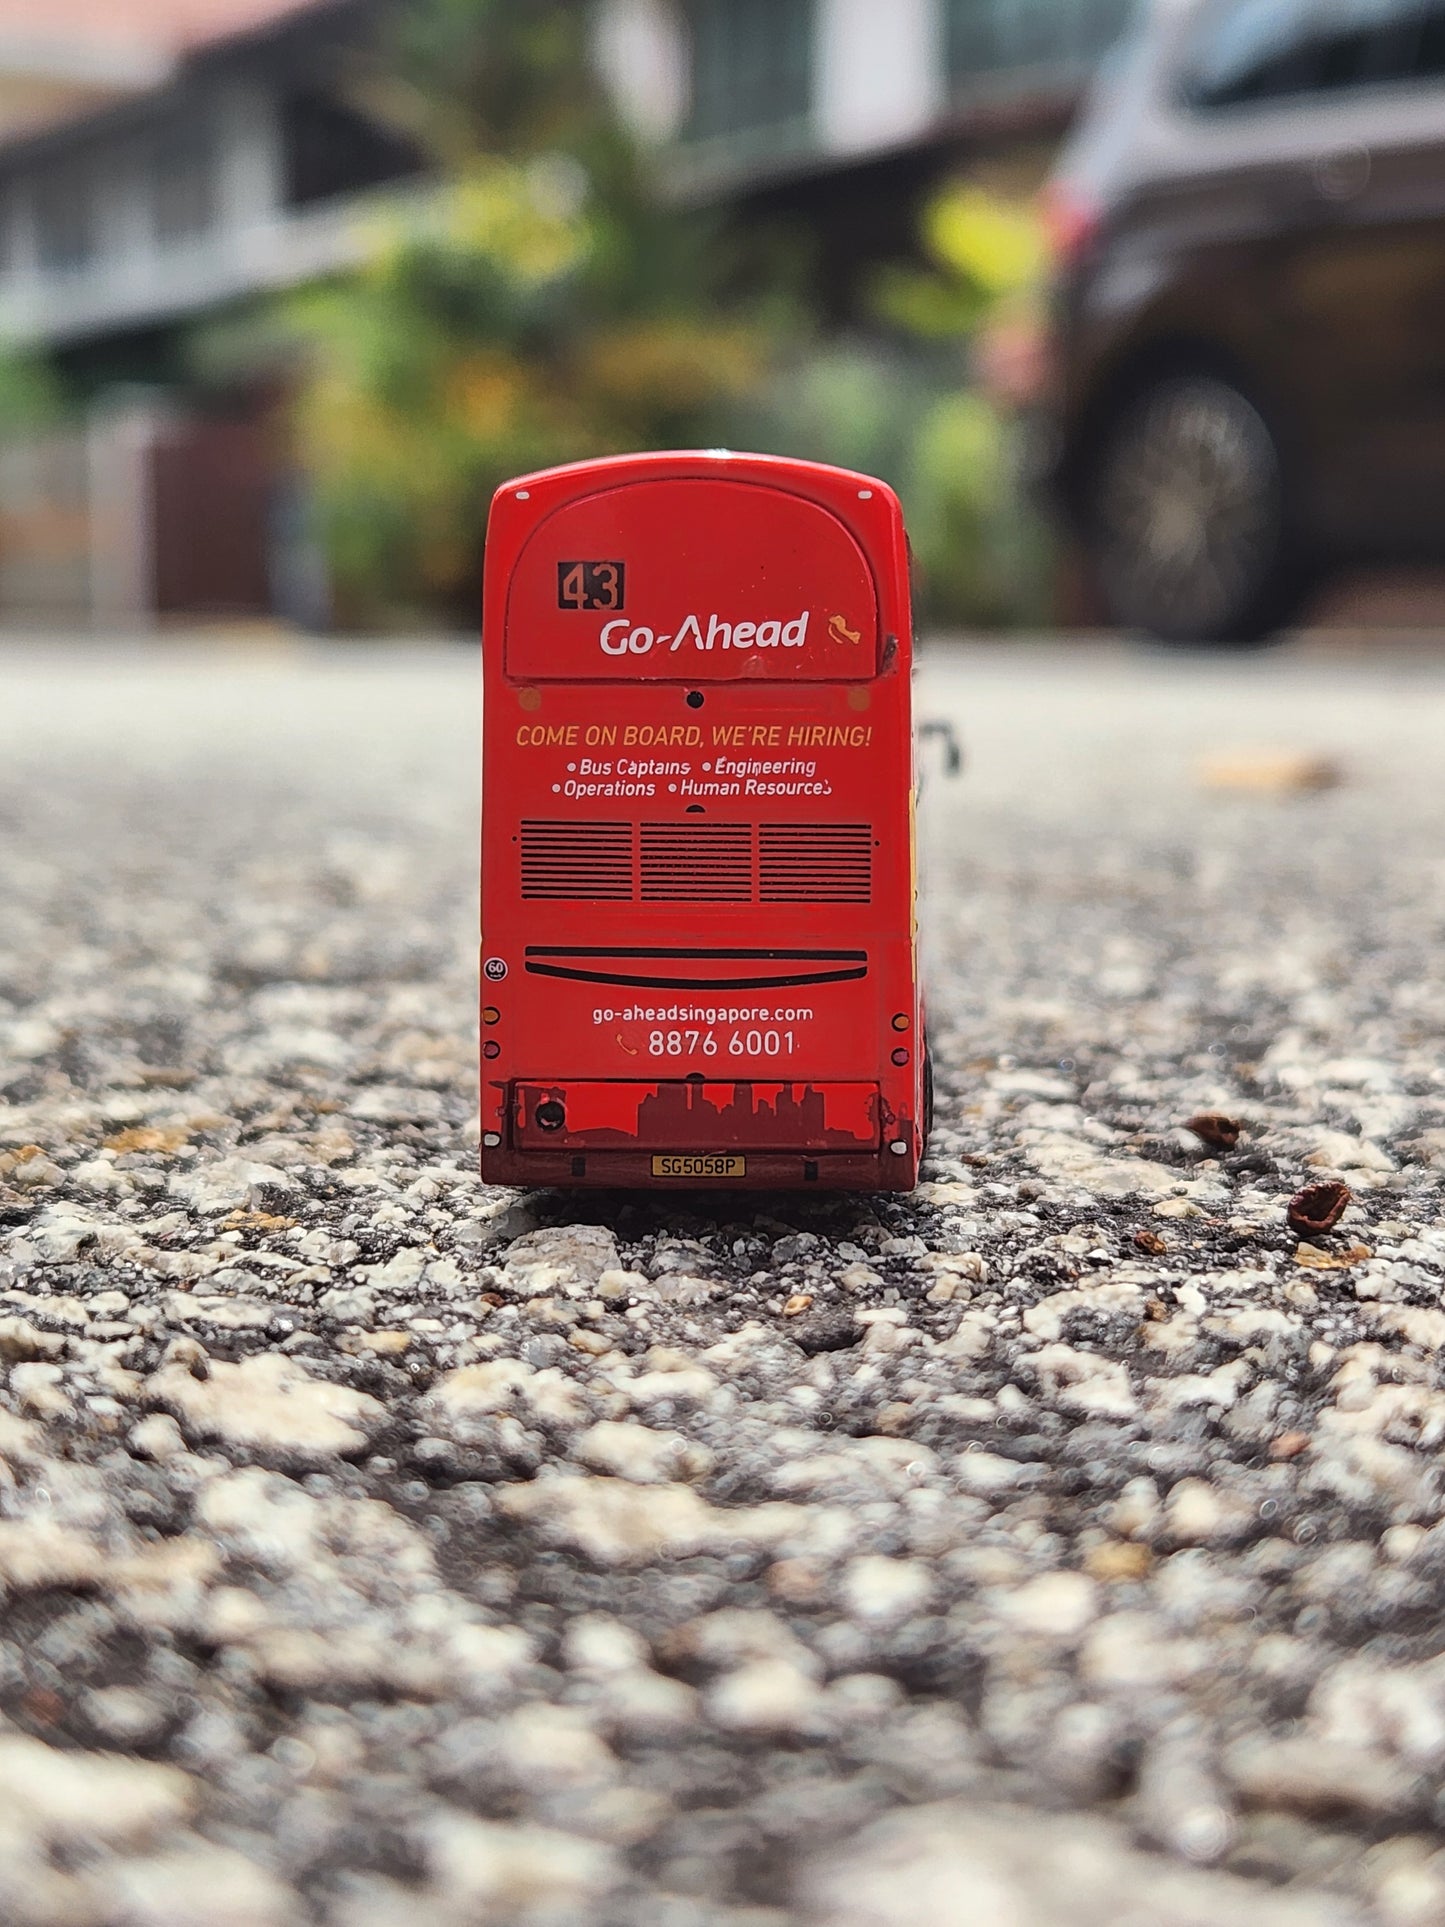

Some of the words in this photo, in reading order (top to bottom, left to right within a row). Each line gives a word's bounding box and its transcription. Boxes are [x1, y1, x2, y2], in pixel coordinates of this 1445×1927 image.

[562, 562, 618, 610] 43
[599, 611, 809, 655] Go-Ahead
[516, 725, 577, 747] COME
[585, 725, 617, 747] ON
[623, 725, 704, 748] BOARD,
[712, 725, 782, 747] WE'RE
[788, 725, 872, 747] HIRING!
[580, 758, 612, 775] Bus
[617, 758, 692, 778] Captains
[715, 756, 816, 778] Engineering
[564, 780, 656, 800] Operations
[680, 779, 740, 796] Human
[488, 961, 504, 973] 60
[592, 1004, 813, 1024] go-aheadsingapore.com
[648, 1030, 718, 1056] 8876
[728, 1030, 795, 1056] 6001
[661, 1158, 736, 1174] SG5058P
